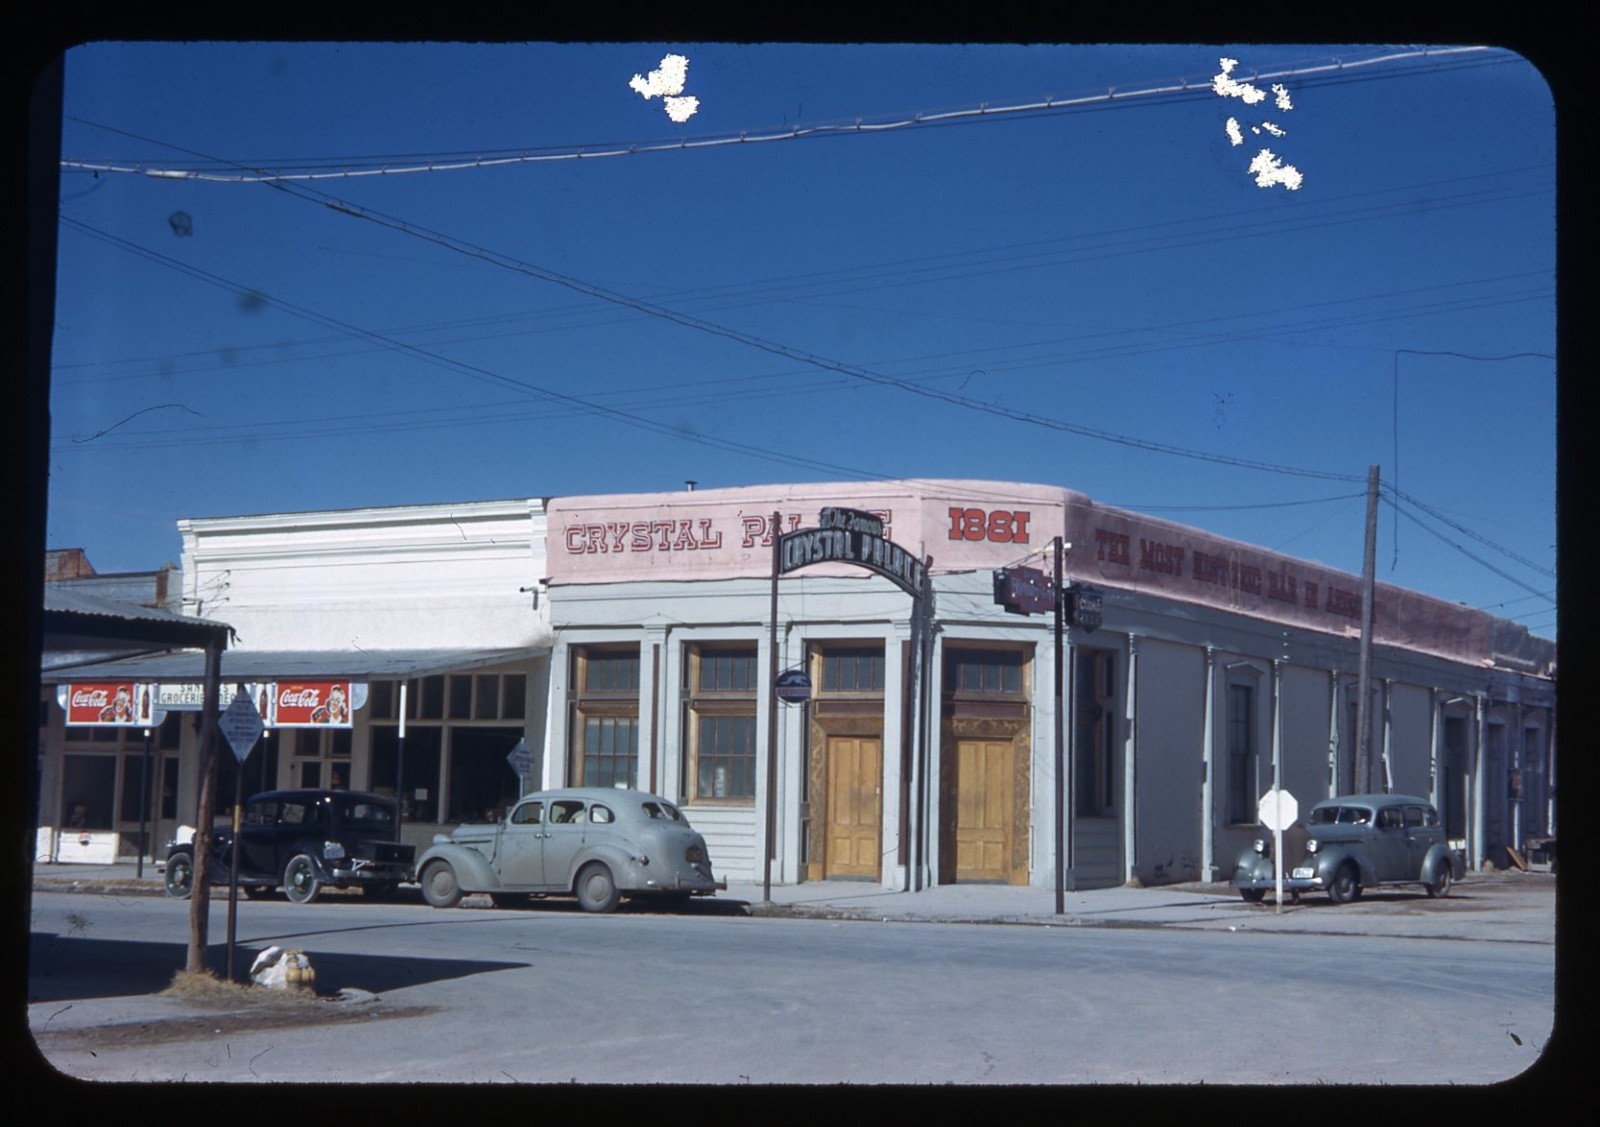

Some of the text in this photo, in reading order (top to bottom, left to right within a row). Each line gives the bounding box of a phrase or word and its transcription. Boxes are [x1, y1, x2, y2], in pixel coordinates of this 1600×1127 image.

[566, 518, 723, 554] CRYSTAL
[948, 507, 1031, 544] 1881
[783, 529, 923, 592] CRYSTAL PALACE
[1096, 529, 1131, 566] THE
[1138, 538, 1185, 577] MOST
[72, 690, 109, 708] Coca-Cola
[161, 692, 205, 705] GROCERIE
[279, 688, 321, 708] Coca-Cola
